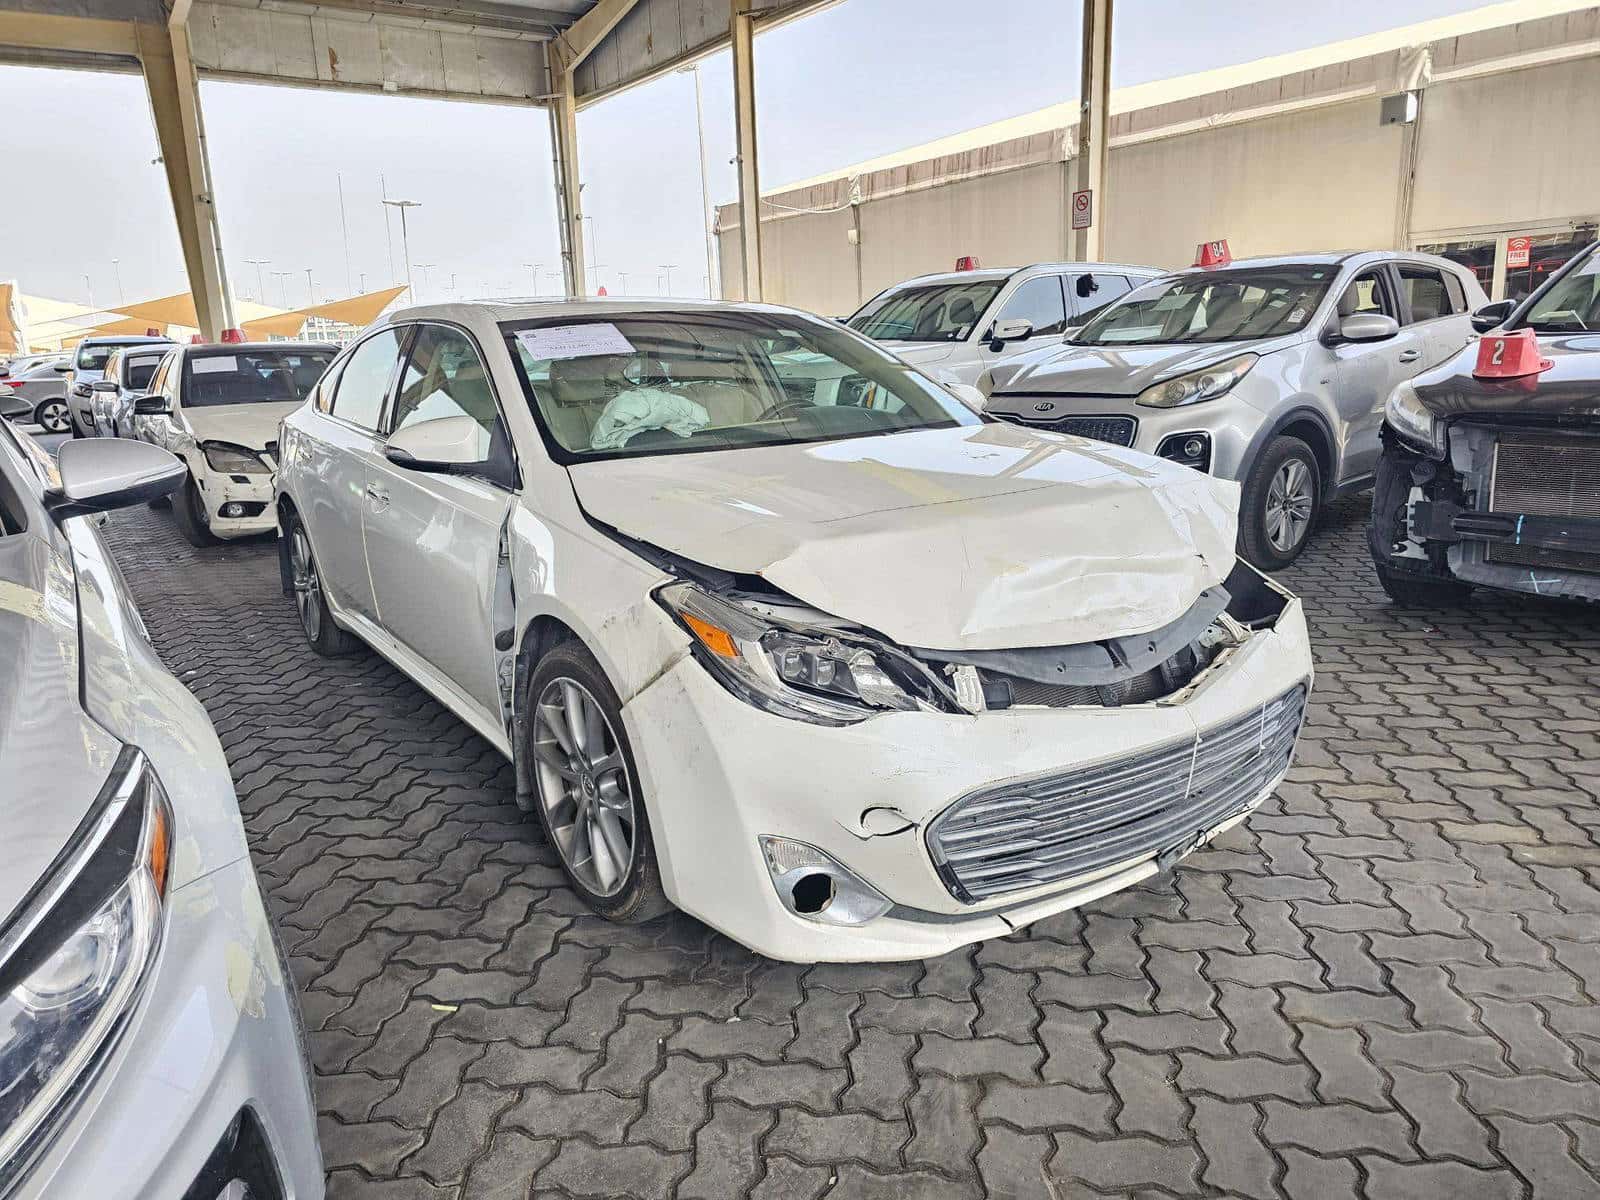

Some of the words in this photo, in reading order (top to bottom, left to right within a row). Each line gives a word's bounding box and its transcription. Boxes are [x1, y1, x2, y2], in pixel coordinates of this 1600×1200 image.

[1212, 241, 1225, 257] 84
[1510, 251, 1526, 259] FREE
[1491, 340, 1505, 365] 2
[1035, 403, 1052, 411] KIA
